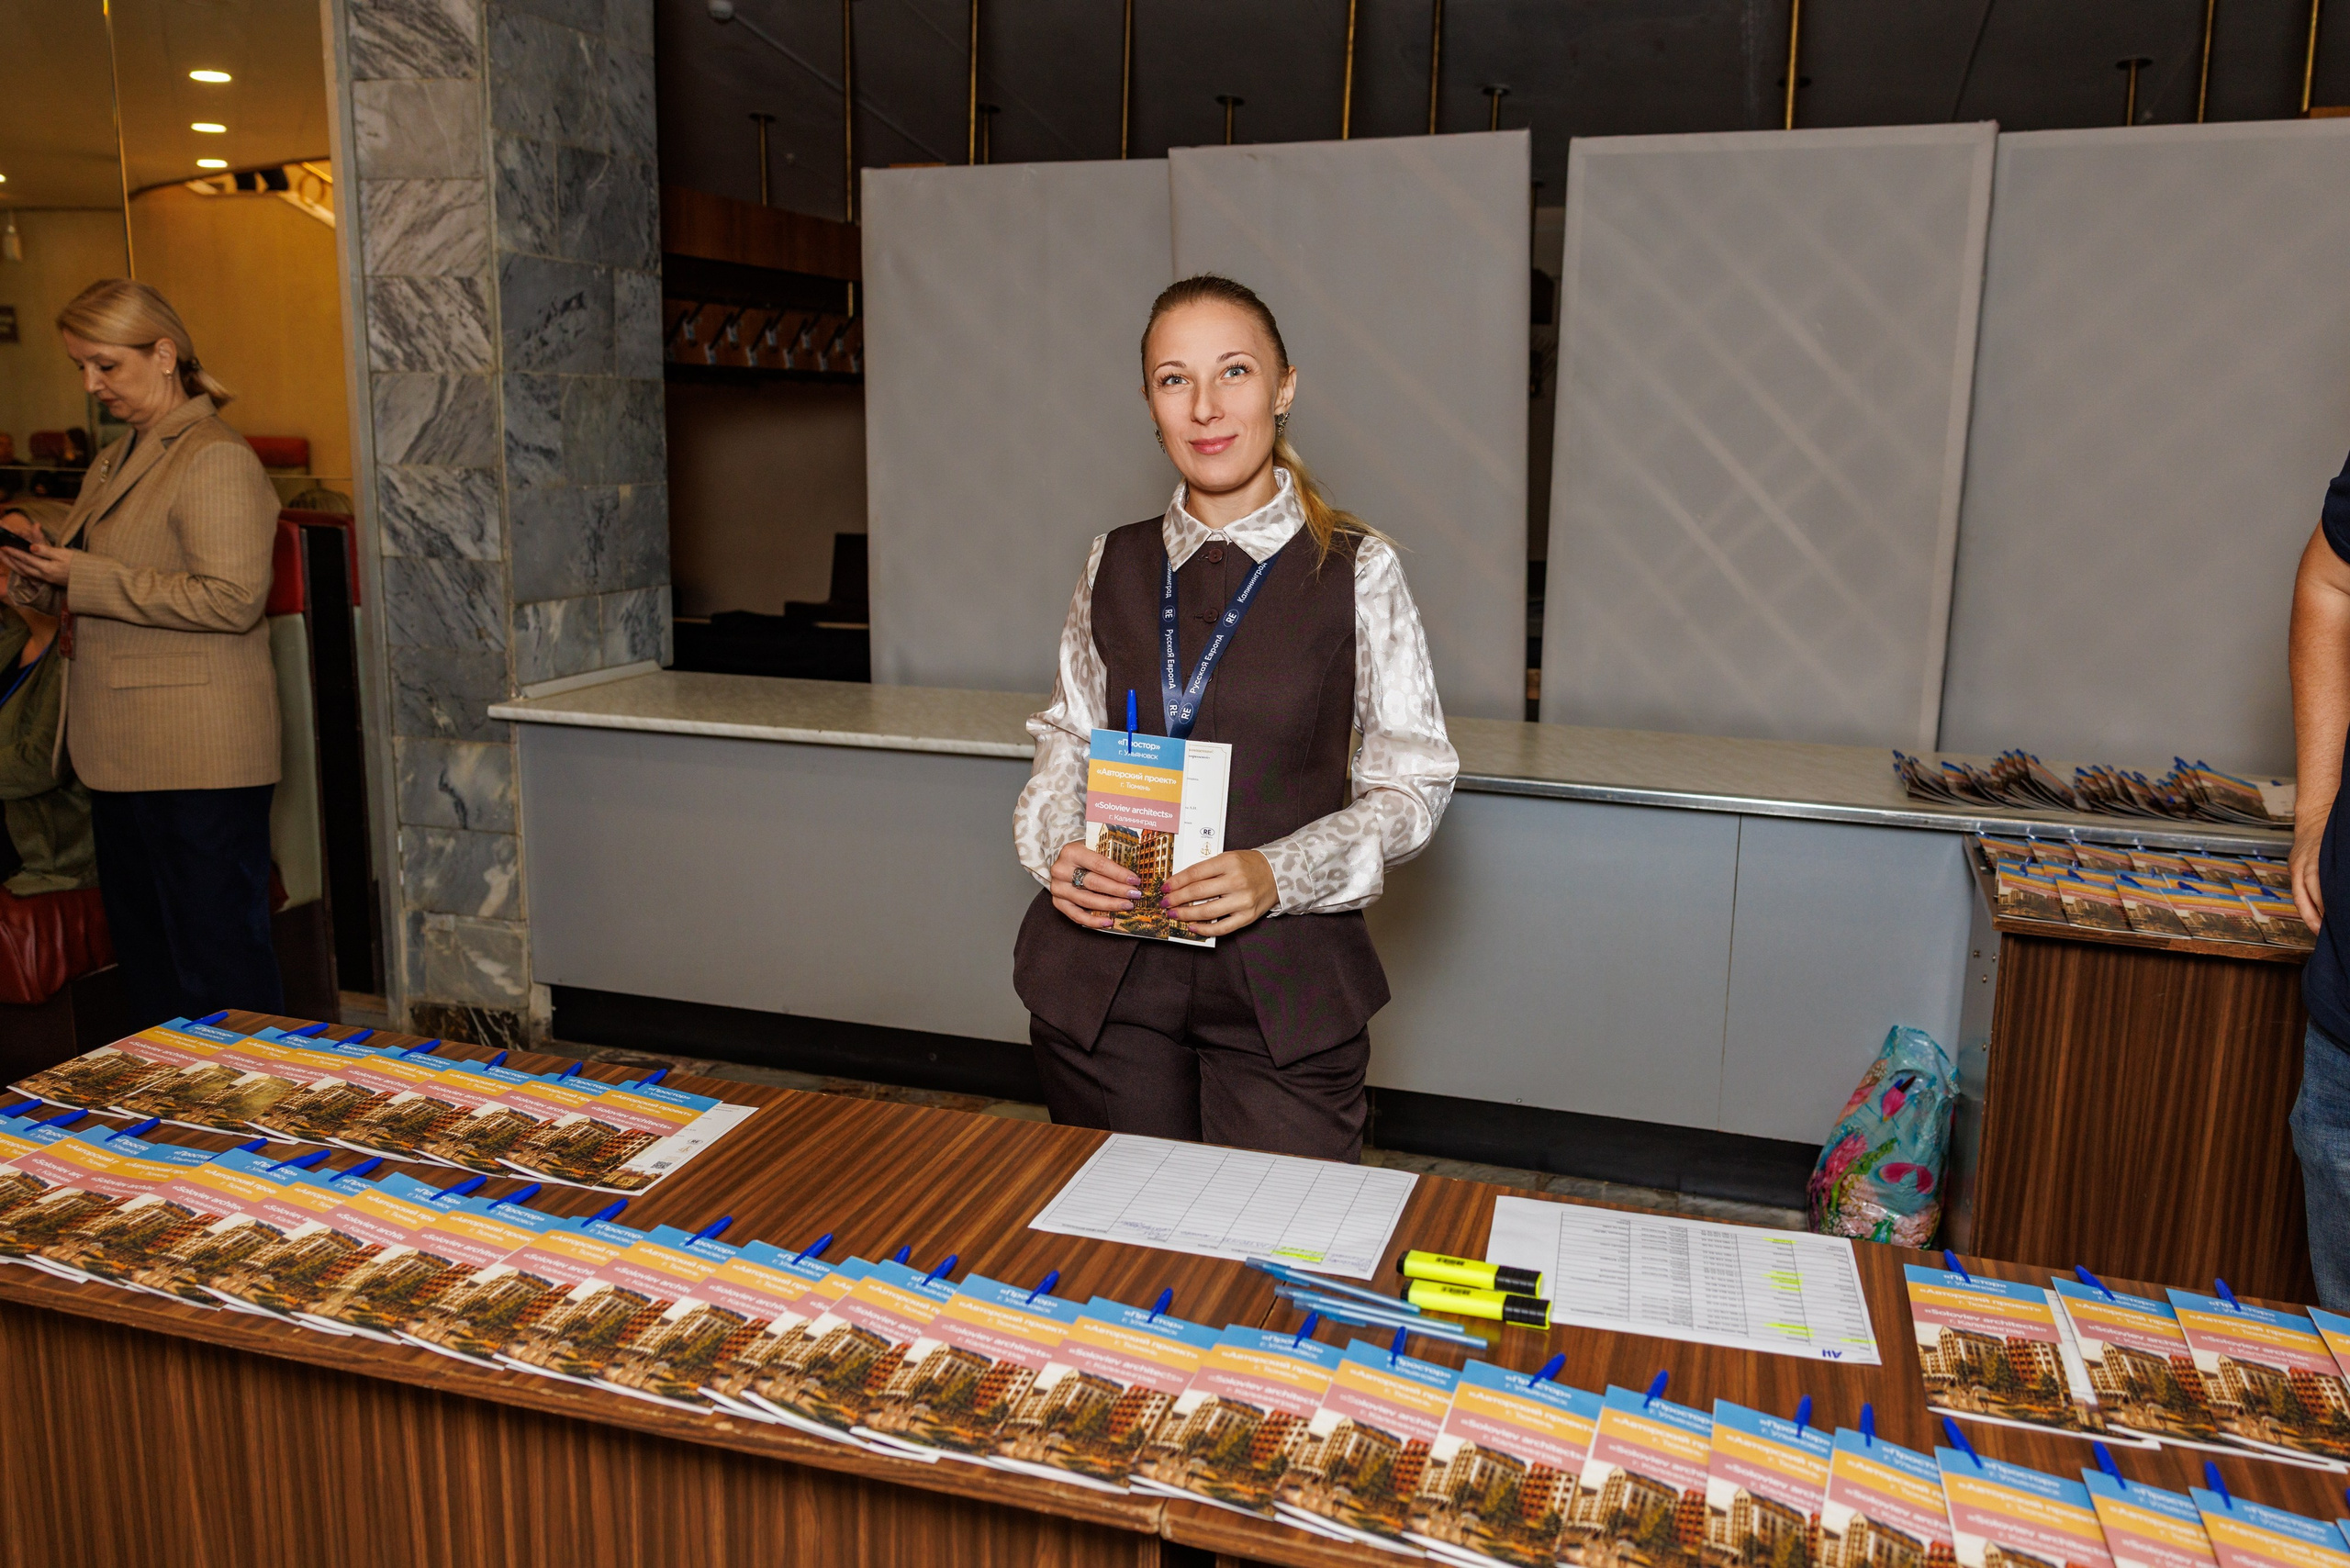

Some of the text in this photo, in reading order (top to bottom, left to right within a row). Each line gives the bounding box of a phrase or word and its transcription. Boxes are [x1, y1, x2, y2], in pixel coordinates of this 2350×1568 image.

[1237, 562, 1267, 603] Калининград
[1165, 609, 1173, 618] RE
[1225, 612, 1237, 624] RE
[1181, 707, 1192, 719] RE
[1118, 739, 1160, 750] «Постор»
[1097, 768, 1143, 780] «Авторский
[1144, 775, 1176, 785] проект»
[1126, 782, 1150, 792] Тюмень
[1095, 801, 1130, 812] «Soloviev
[1132, 807, 1173, 819] architects»
[1114, 815, 1157, 827] Калининград
[410, 1055, 450, 1065] «Простор»
[489, 1068, 529, 1079] «Простор»
[649, 1088, 690, 1099] «Простор»
[612, 1095, 692, 1116] «Авторский проект»
[592, 1107, 671, 1129] «Soloviev architects»
[205, 1170, 255, 1186] «Авторский
[173, 1186, 212, 1200] «Soloviev
[367, 1196, 419, 1215] «Авторский
[497, 1205, 545, 1221] «Простор»
[337, 1213, 377, 1229] «Soloviev
[450, 1217, 504, 1232] «Авторский
[422, 1234, 464, 1247] «Soloviev
